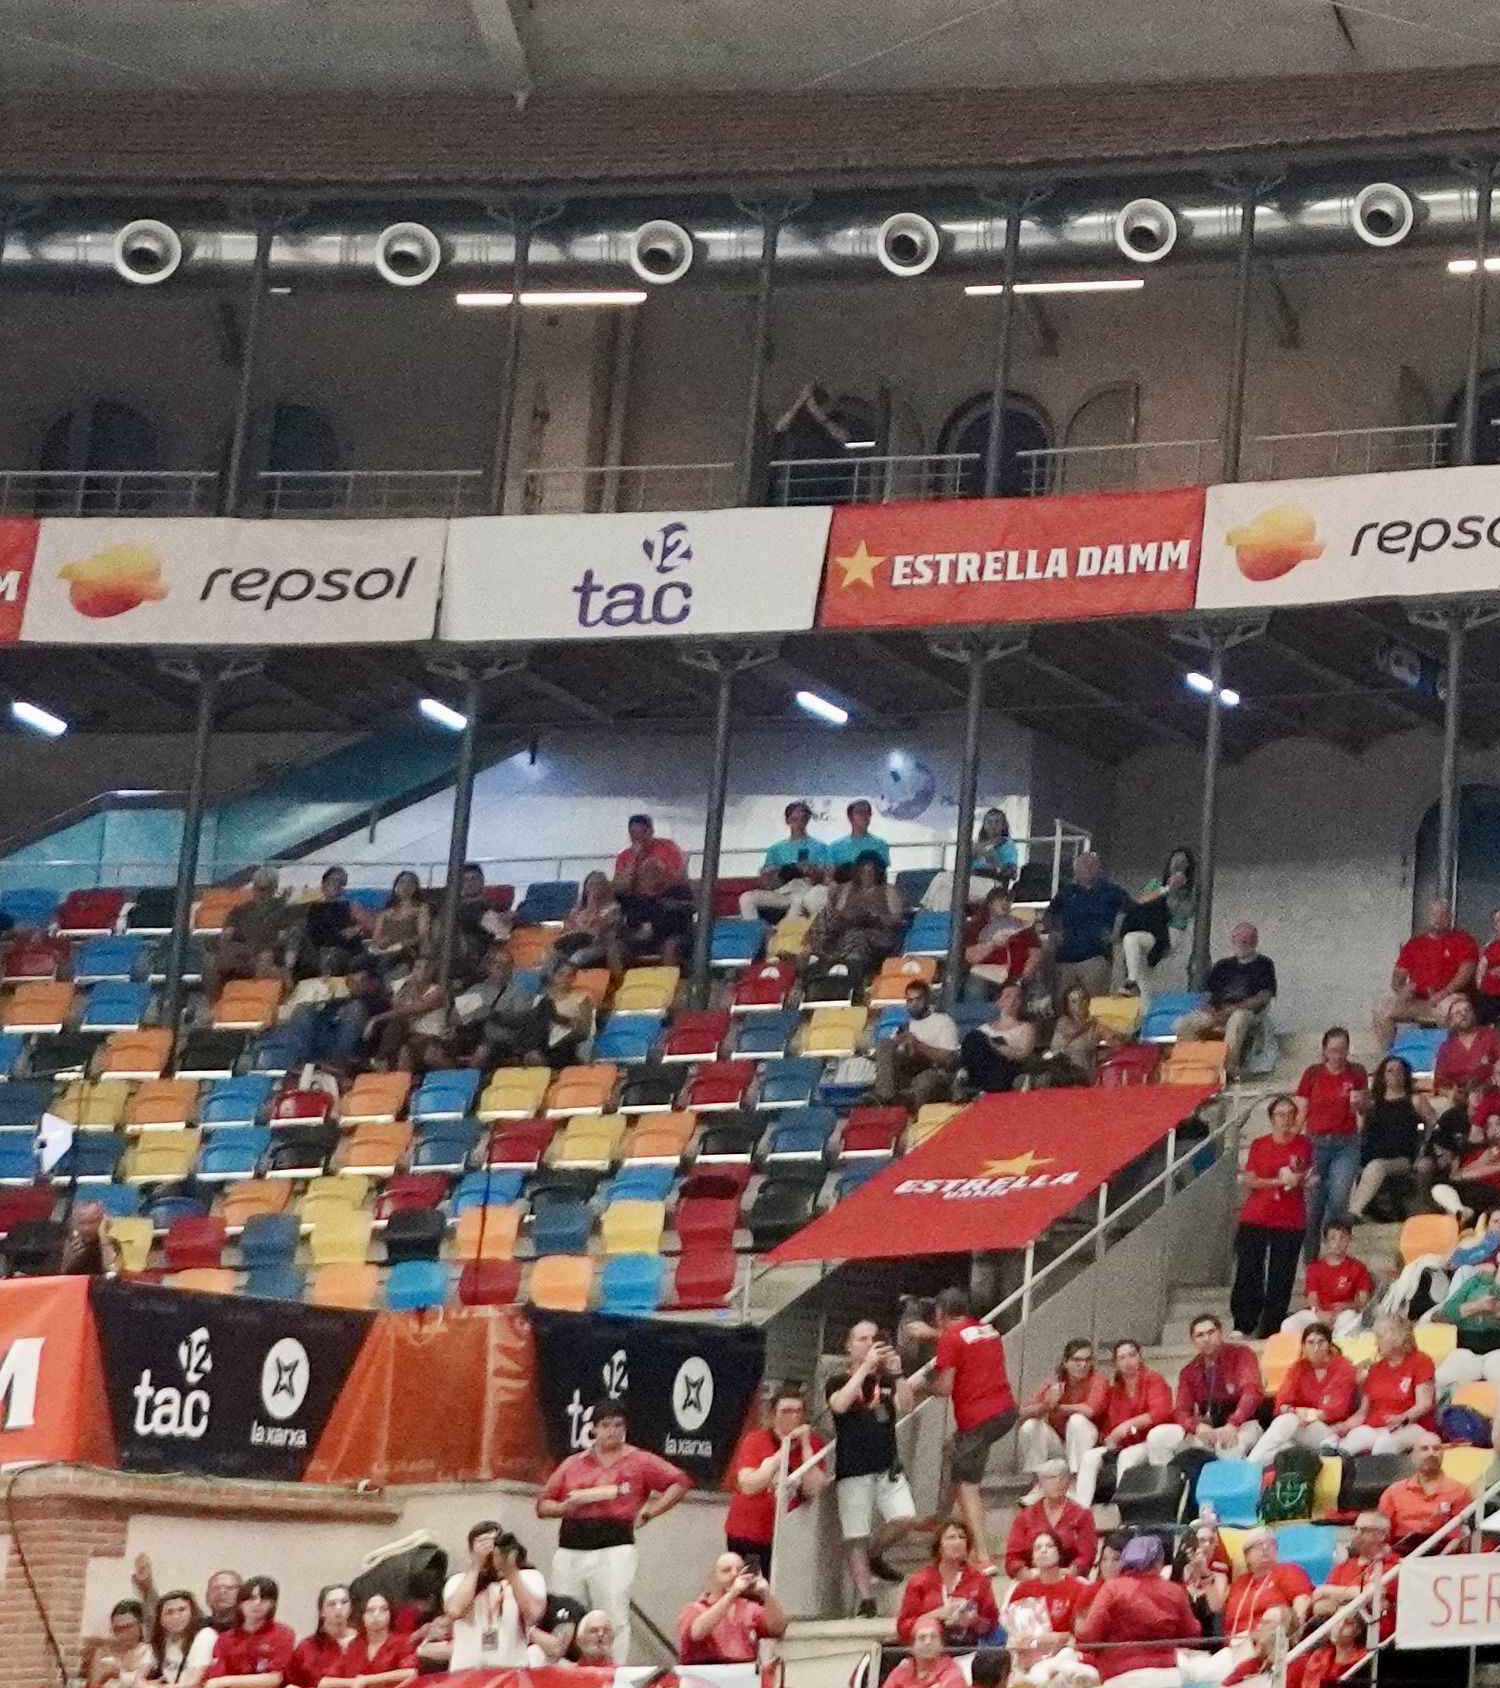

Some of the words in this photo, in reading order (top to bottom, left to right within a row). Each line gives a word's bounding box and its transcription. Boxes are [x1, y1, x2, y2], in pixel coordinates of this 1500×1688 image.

[200, 557, 418, 611] repsol
[891, 546, 1069, 587] ESTRELLA
[1075, 539, 1190, 578] DAMM
[573, 569, 693, 629] tac
[894, 1171, 1079, 1195] ESTRELLA
[134, 1368, 211, 1438] tac
